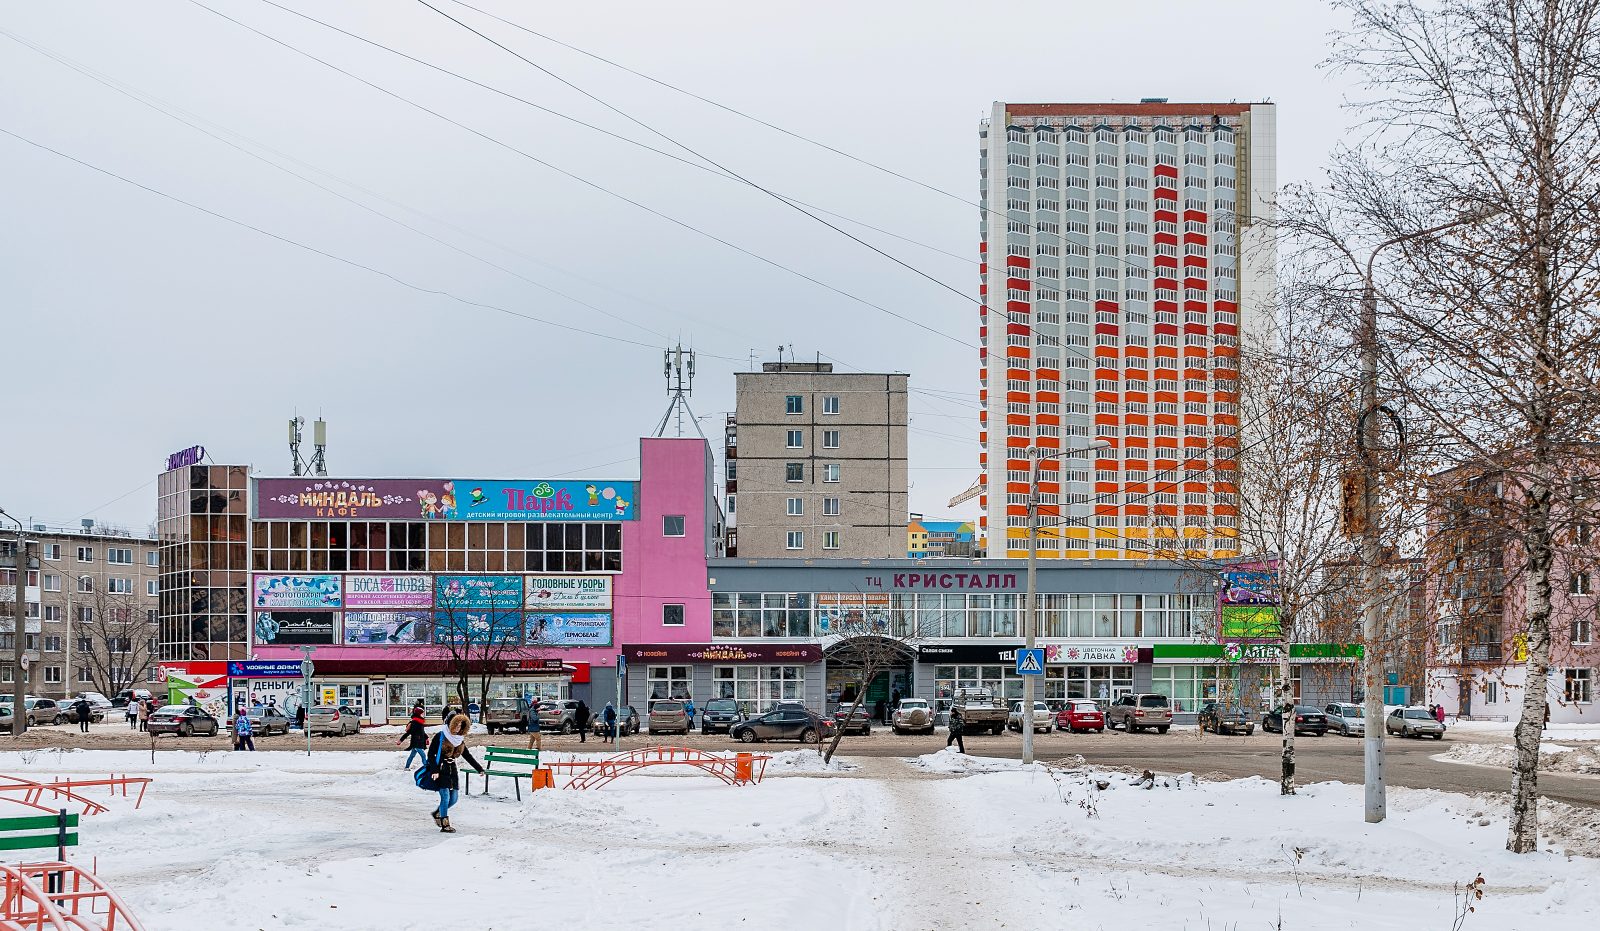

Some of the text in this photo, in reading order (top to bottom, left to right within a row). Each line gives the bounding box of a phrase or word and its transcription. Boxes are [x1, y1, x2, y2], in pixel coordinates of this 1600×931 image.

[300, 491, 382, 508] МИНДАЛЬ
[502, 487, 575, 514] Парк
[316, 507, 358, 517] КАФЕ
[528, 511, 591, 519] развлекательный
[353, 577, 380, 592] БОСА
[532, 578, 605, 589] ГОЛОВНЫЕ УБОРЫ
[866, 573, 1017, 589] ТЦ КРИСТАЛЛ
[702, 650, 748, 660] МИНДАЛЬ
[1082, 652, 1116, 660] ЛАВКА
[253, 681, 294, 692] ДЕНЬГИ
[262, 694, 277, 705] 15
